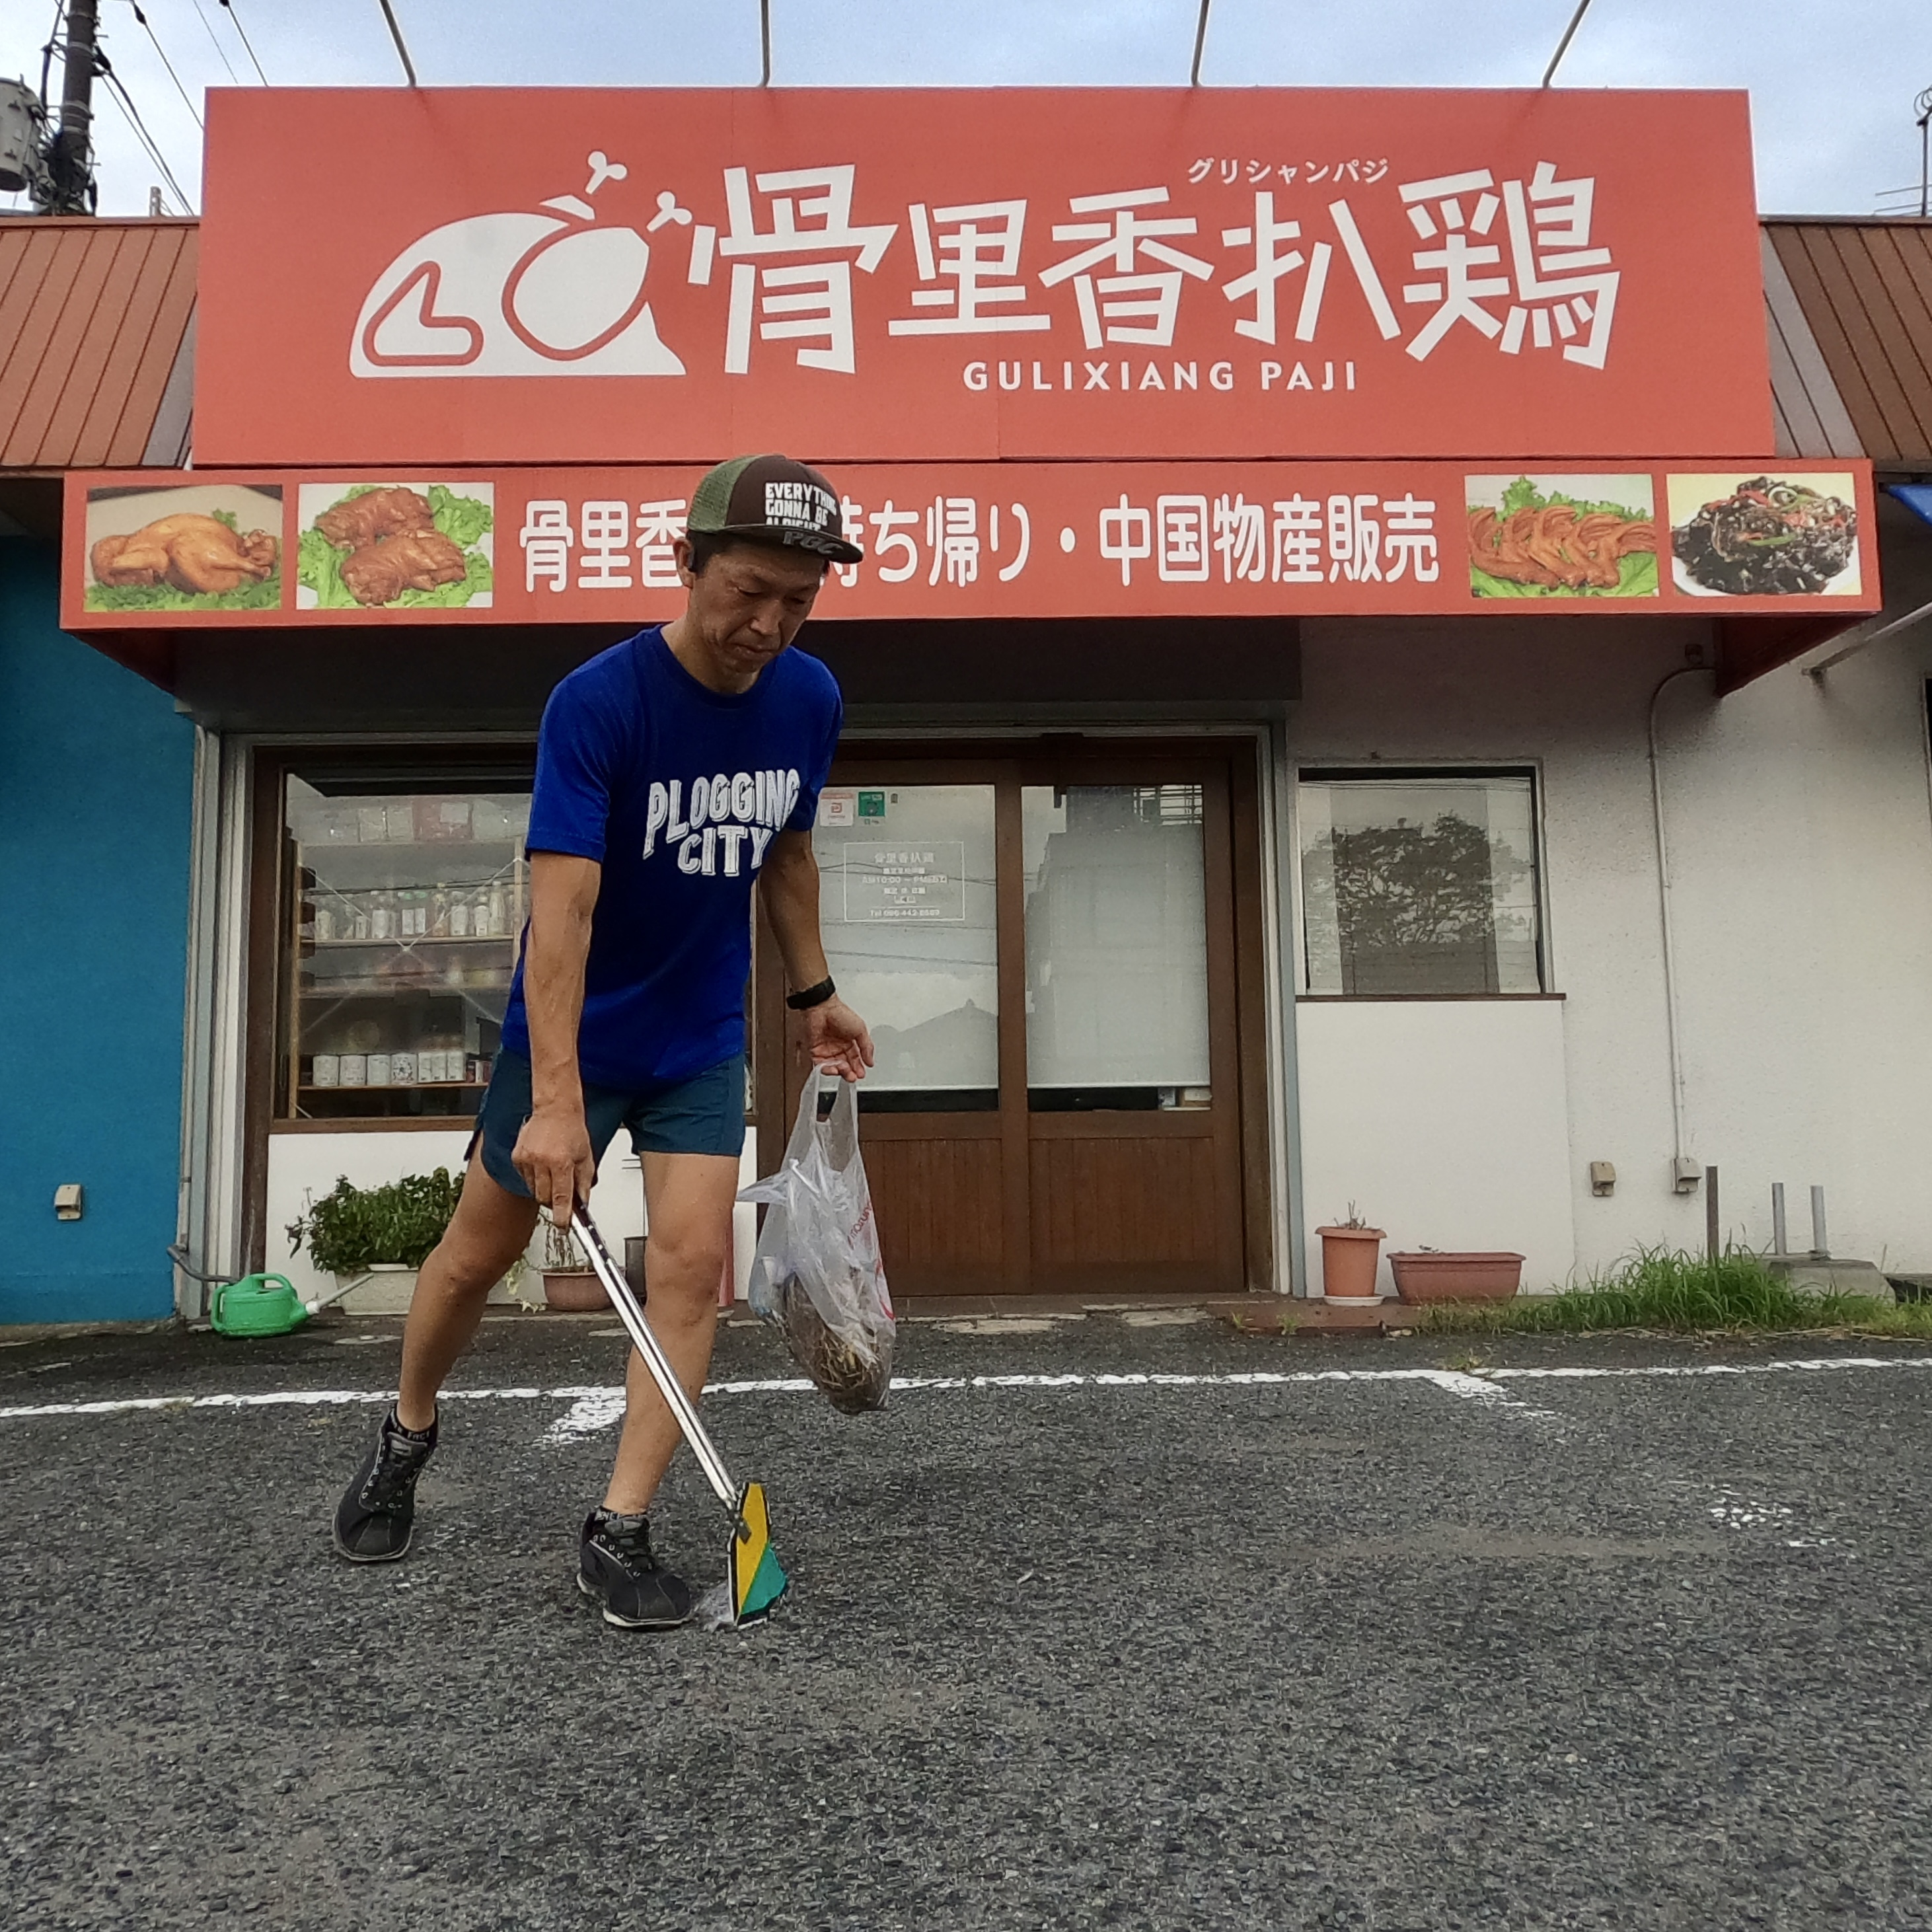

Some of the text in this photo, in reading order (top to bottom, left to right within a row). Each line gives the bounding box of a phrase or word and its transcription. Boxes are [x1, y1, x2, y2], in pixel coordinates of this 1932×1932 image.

[1188, 157, 1388, 184] グリシャンパジ
[688, 161, 1621, 375] 骨里香扒鶏
[963, 361, 1356, 391] GULIXIANG PAJI
[764, 498, 829, 527] GONNA BE
[642, 768, 801, 860] PLOGGING
[677, 825, 774, 877] CITY
